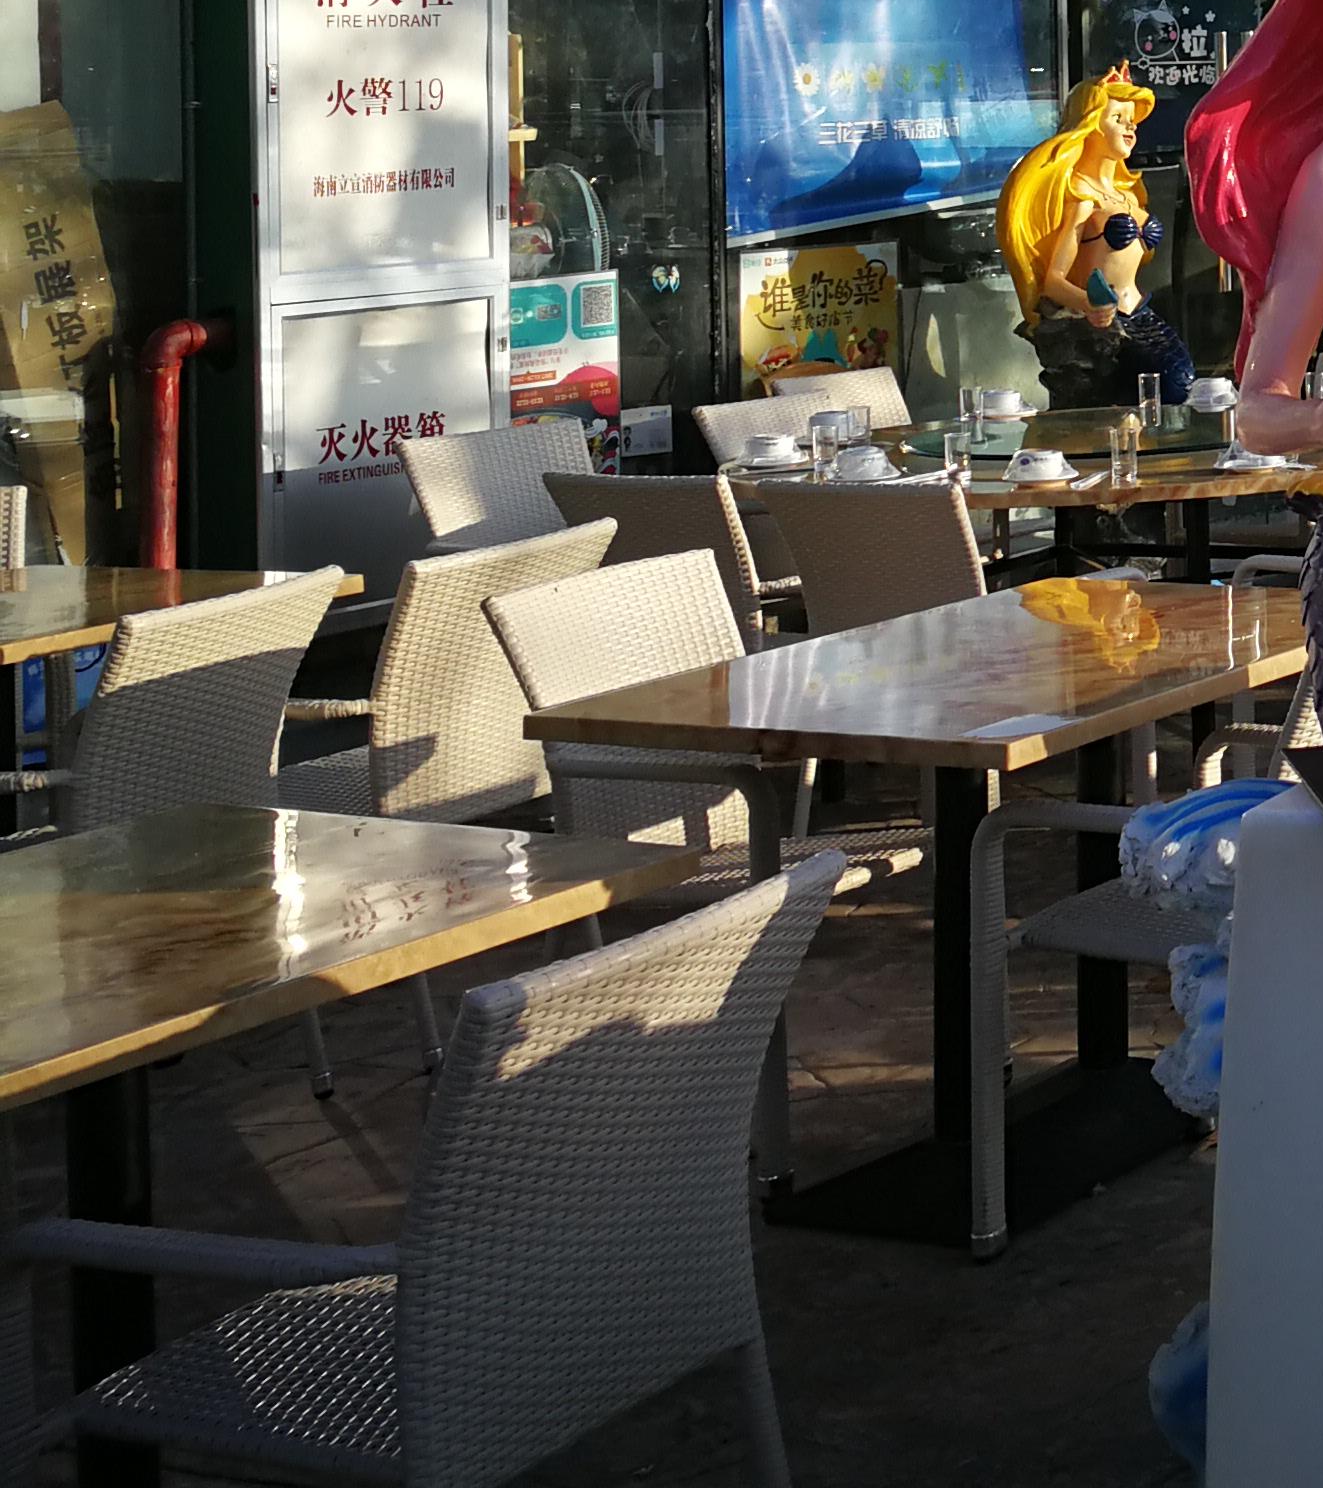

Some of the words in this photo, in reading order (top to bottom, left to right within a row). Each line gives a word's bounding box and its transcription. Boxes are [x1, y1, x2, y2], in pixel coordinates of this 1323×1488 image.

[327, 15, 362, 28] FIRE
[367, 14, 442, 28] HYDRANT
[1182, 24, 1208, 57] 拉
[1149, 64, 1217, 86] 欢迎光临
[326, 77, 444, 118] 火警119
[818, 121, 888, 146] 三花三草
[318, 468, 341, 485] FIRE
